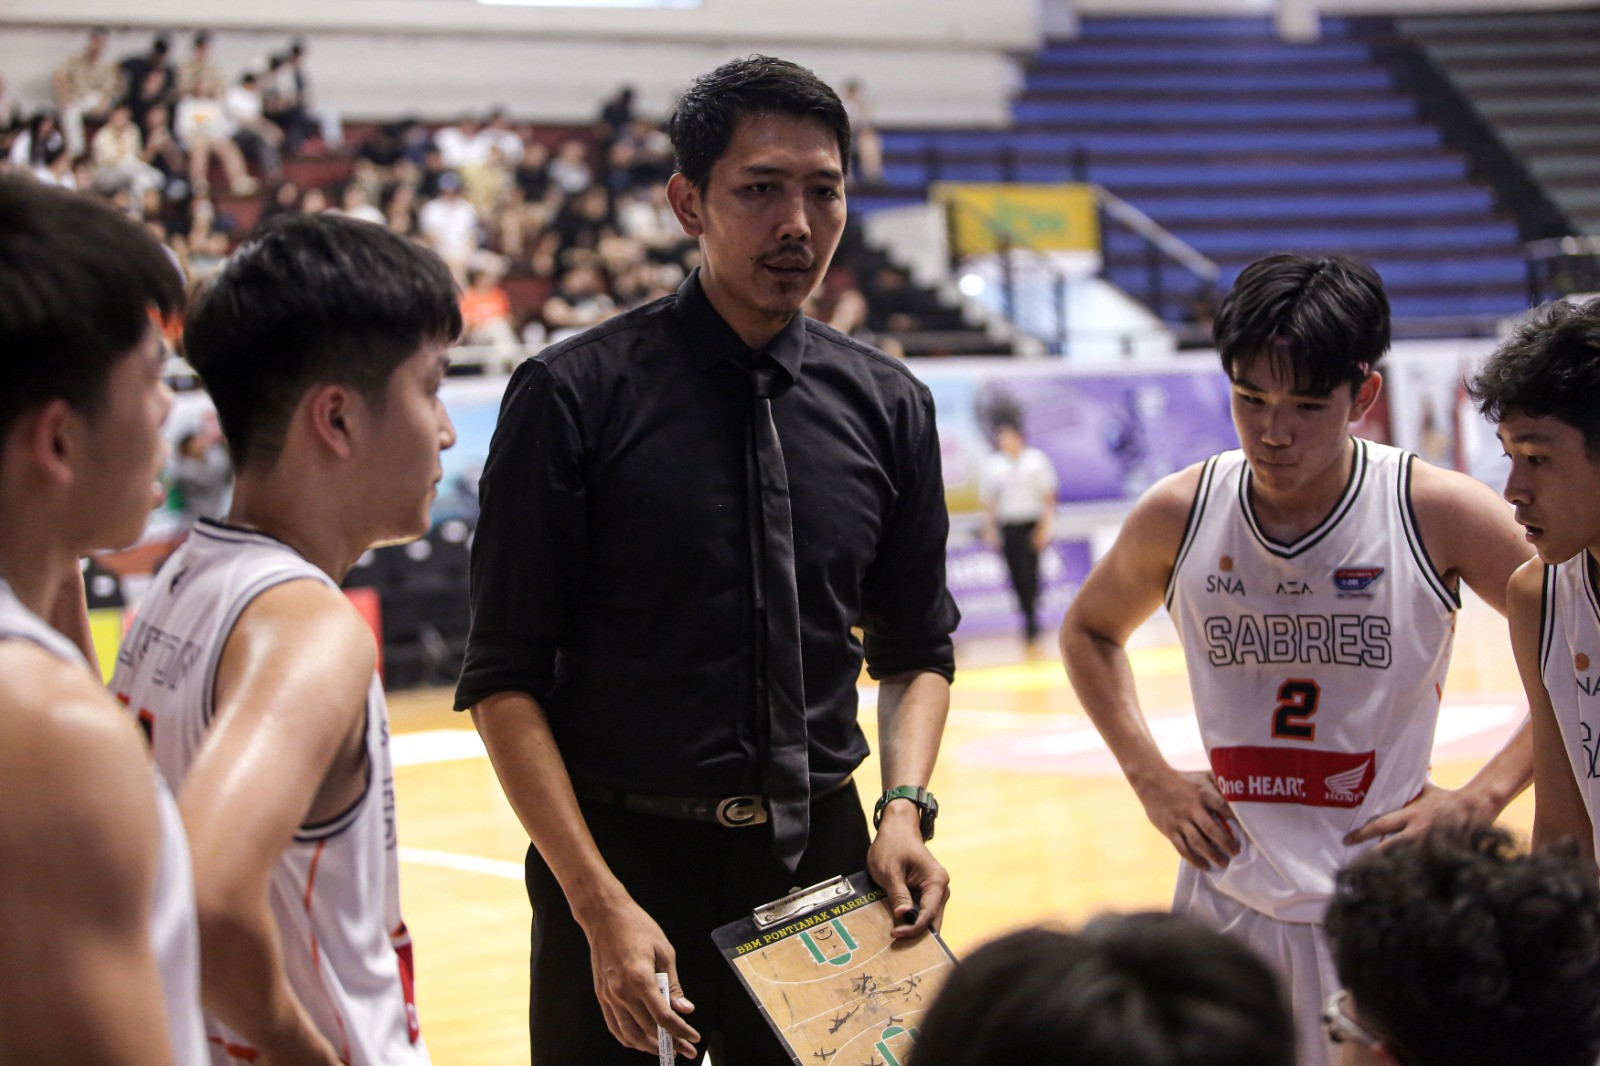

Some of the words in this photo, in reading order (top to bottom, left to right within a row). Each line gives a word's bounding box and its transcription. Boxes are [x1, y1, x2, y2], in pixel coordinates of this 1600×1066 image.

[1206, 574, 1246, 596] SNA
[1204, 614, 1392, 669] SABRES
[1271, 678, 1321, 741] 2
[1218, 775, 1244, 796] One
[735, 939, 762, 955] BBM
[764, 911, 831, 944] PONTIANAK
